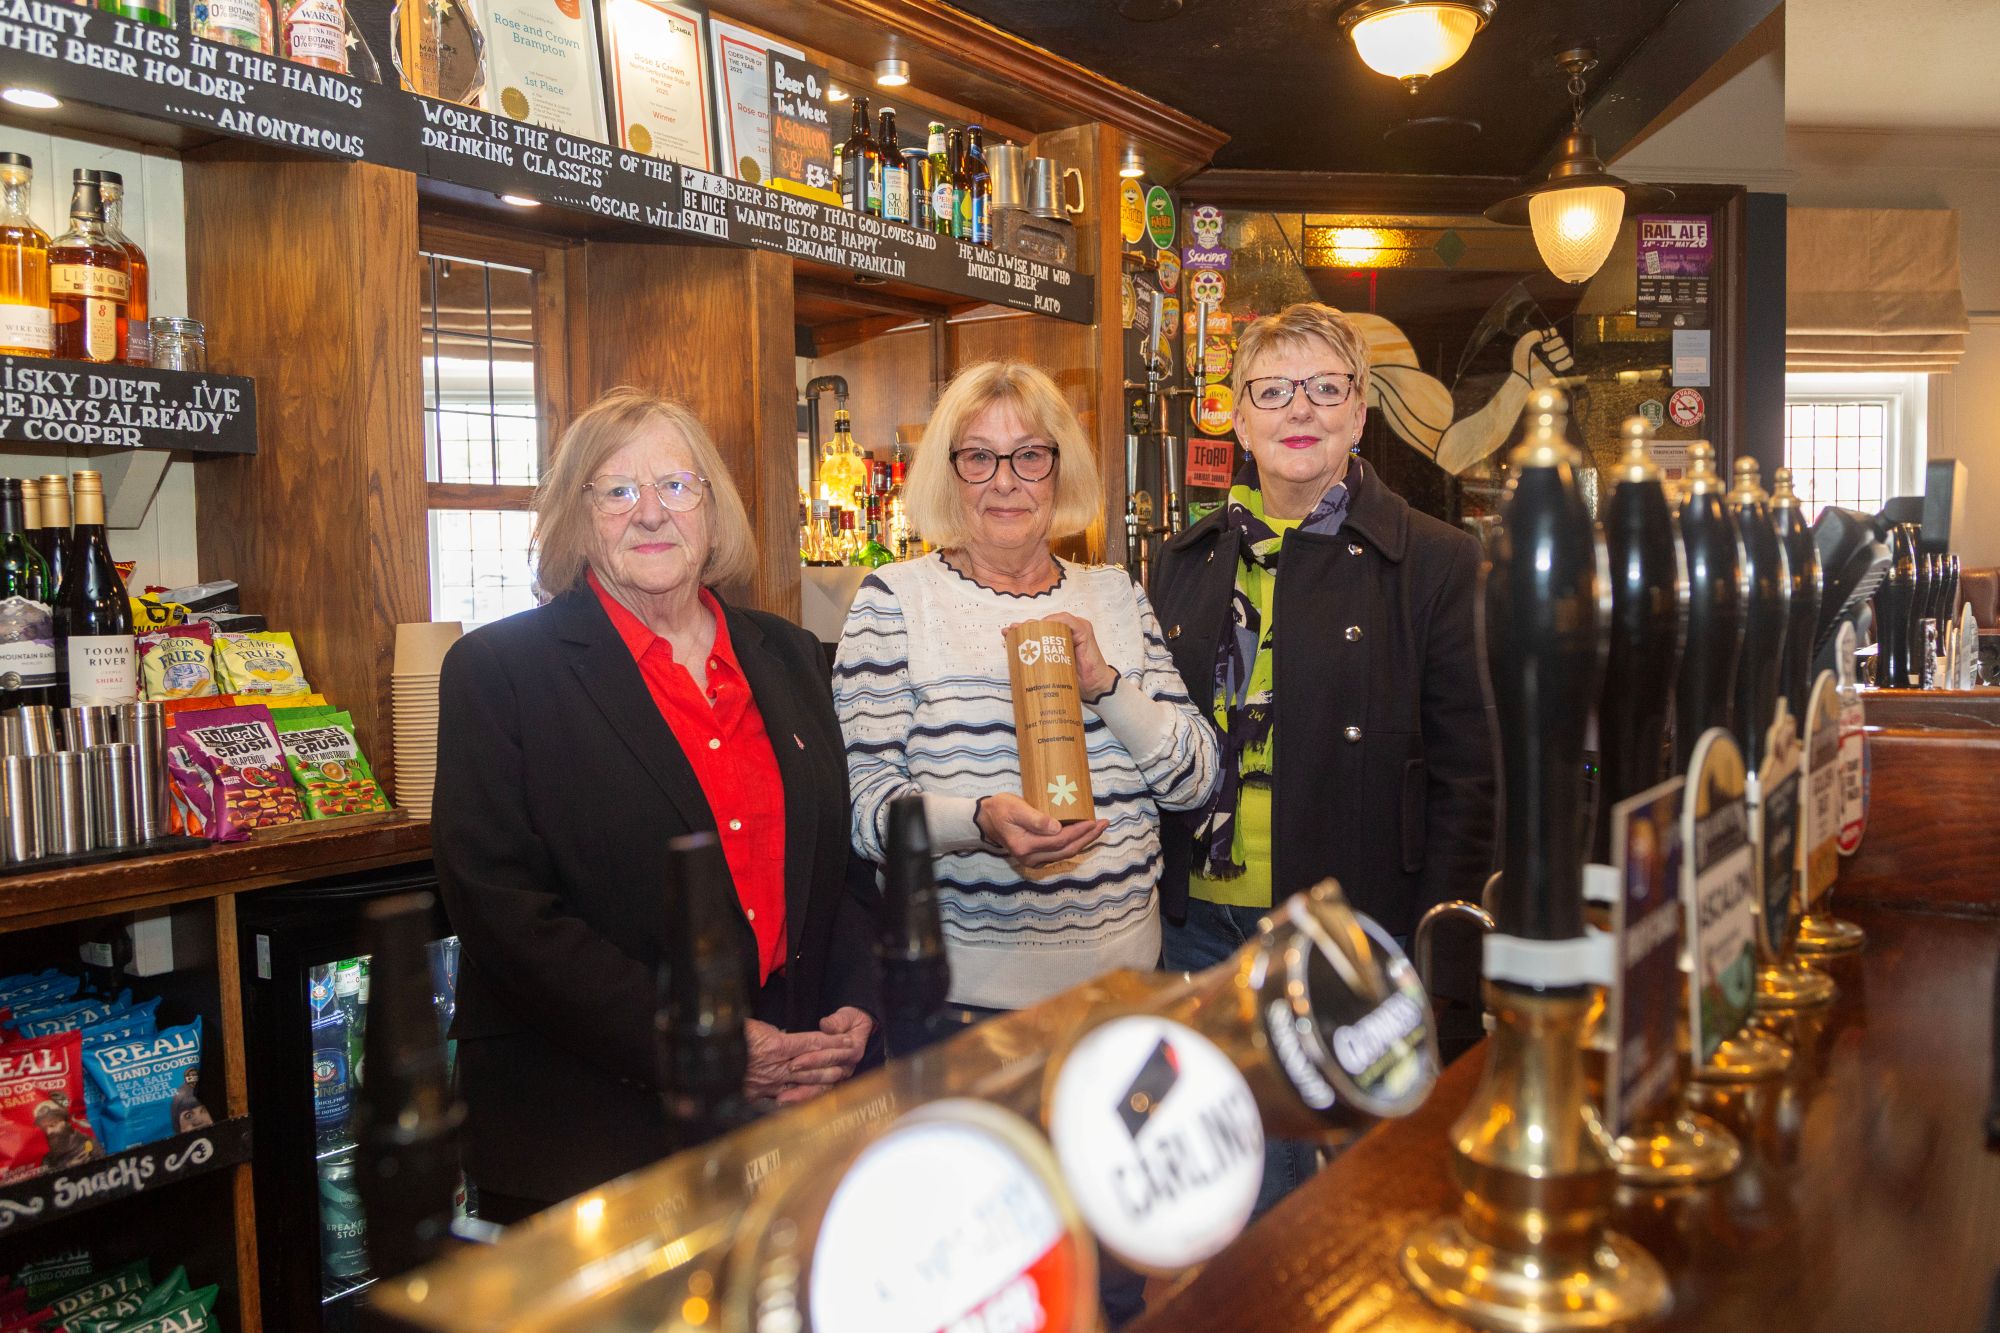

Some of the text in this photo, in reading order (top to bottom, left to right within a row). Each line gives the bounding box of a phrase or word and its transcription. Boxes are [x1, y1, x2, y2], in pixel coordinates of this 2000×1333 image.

[308, 35, 336, 47] BOTANIC
[494, 13, 521, 31] Rose
[523, 22, 544, 38] and
[545, 30, 581, 50] Crown
[0, 21, 59, 59] THE
[64, 38, 139, 78] BEER
[512, 32, 567, 58] Brampton
[114, 21, 181, 58] LIES
[189, 37, 219, 70] IN
[225, 51, 277, 84] THE
[282, 66, 363, 109] HANDS
[728, 50, 763, 67] CIDER PUB OF
[729, 58, 755, 72] THE YEAR
[662, 62, 685, 77] Crown
[730, 66, 743, 75] 2025
[774, 61, 805, 95] Beer
[525, 76, 538, 89] 1st
[539, 81, 565, 96] Place
[737, 102, 755, 118] Rose
[773, 92, 795, 117] The
[653, 110, 677, 125] Winner
[421, 127, 513, 167] DRINKING
[491, 115, 508, 141] IS
[514, 125, 549, 151] THE
[556, 137, 613, 168] CURSE
[620, 154, 641, 174] OF
[641, 159, 673, 184] THE
[683, 190, 726, 217] BE NICE
[683, 210, 728, 237] SAY HI
[726, 182, 937, 250] BEER IS PROOF THAT GOD LOVES AND
[735, 207, 782, 234] WANTS
[785, 216, 801, 237] US
[802, 222, 818, 242] TO
[820, 224, 837, 244] BE
[1643, 224, 1706, 240] RAIL ALE
[1689, 236, 1707, 248] 26
[850, 251, 906, 278] FRANKLIN
[967, 259, 1011, 287] INVENTED
[976, 247, 996, 266] WAS
[997, 254, 1005, 269] A
[1005, 255, 1028, 276] WISE
[1030, 263, 1049, 282] MAN
[1052, 268, 1071, 286] WHO
[98, 304, 107, 318] 8
[5, 324, 32, 333] WIRE
[30, 395, 100, 422] DAYS
[24, 419, 144, 447] COOPER
[1194, 446, 1228, 467] IFORD
[160, 638, 194, 651] BACON
[236, 639, 276, 650] SCAMPI
[1041, 635, 1067, 647] BEST
[1042, 645, 1065, 656] BAR
[0, 652, 38, 661] MOUNTAIN
[83, 647, 130, 656] TOOMA
[159, 650, 206, 669] FRIES
[236, 649, 286, 661] FRIES
[89, 657, 127, 667] RIVER
[1044, 656, 1073, 667] NONE
[95, 677, 123, 685] SHIRAZ
[1025, 683, 1073, 693] National Awards
[1039, 708, 1067, 718] WINNER
[215, 737, 273, 758] CRUSH
[294, 735, 350, 755] CRUSH
[1037, 736, 1075, 744] Chesterfield
[321, 750, 346, 762] MUSTARD
[103, 1033, 196, 1068] REAL
[112, 1055, 200, 1082] HAND COOKED
[116, 1072, 174, 1092] SEA SALT
[119, 1083, 171, 1100] & CIDER
[121, 1087, 180, 1109] VINEGAR
[54, 1154, 156, 1208] Snacks
